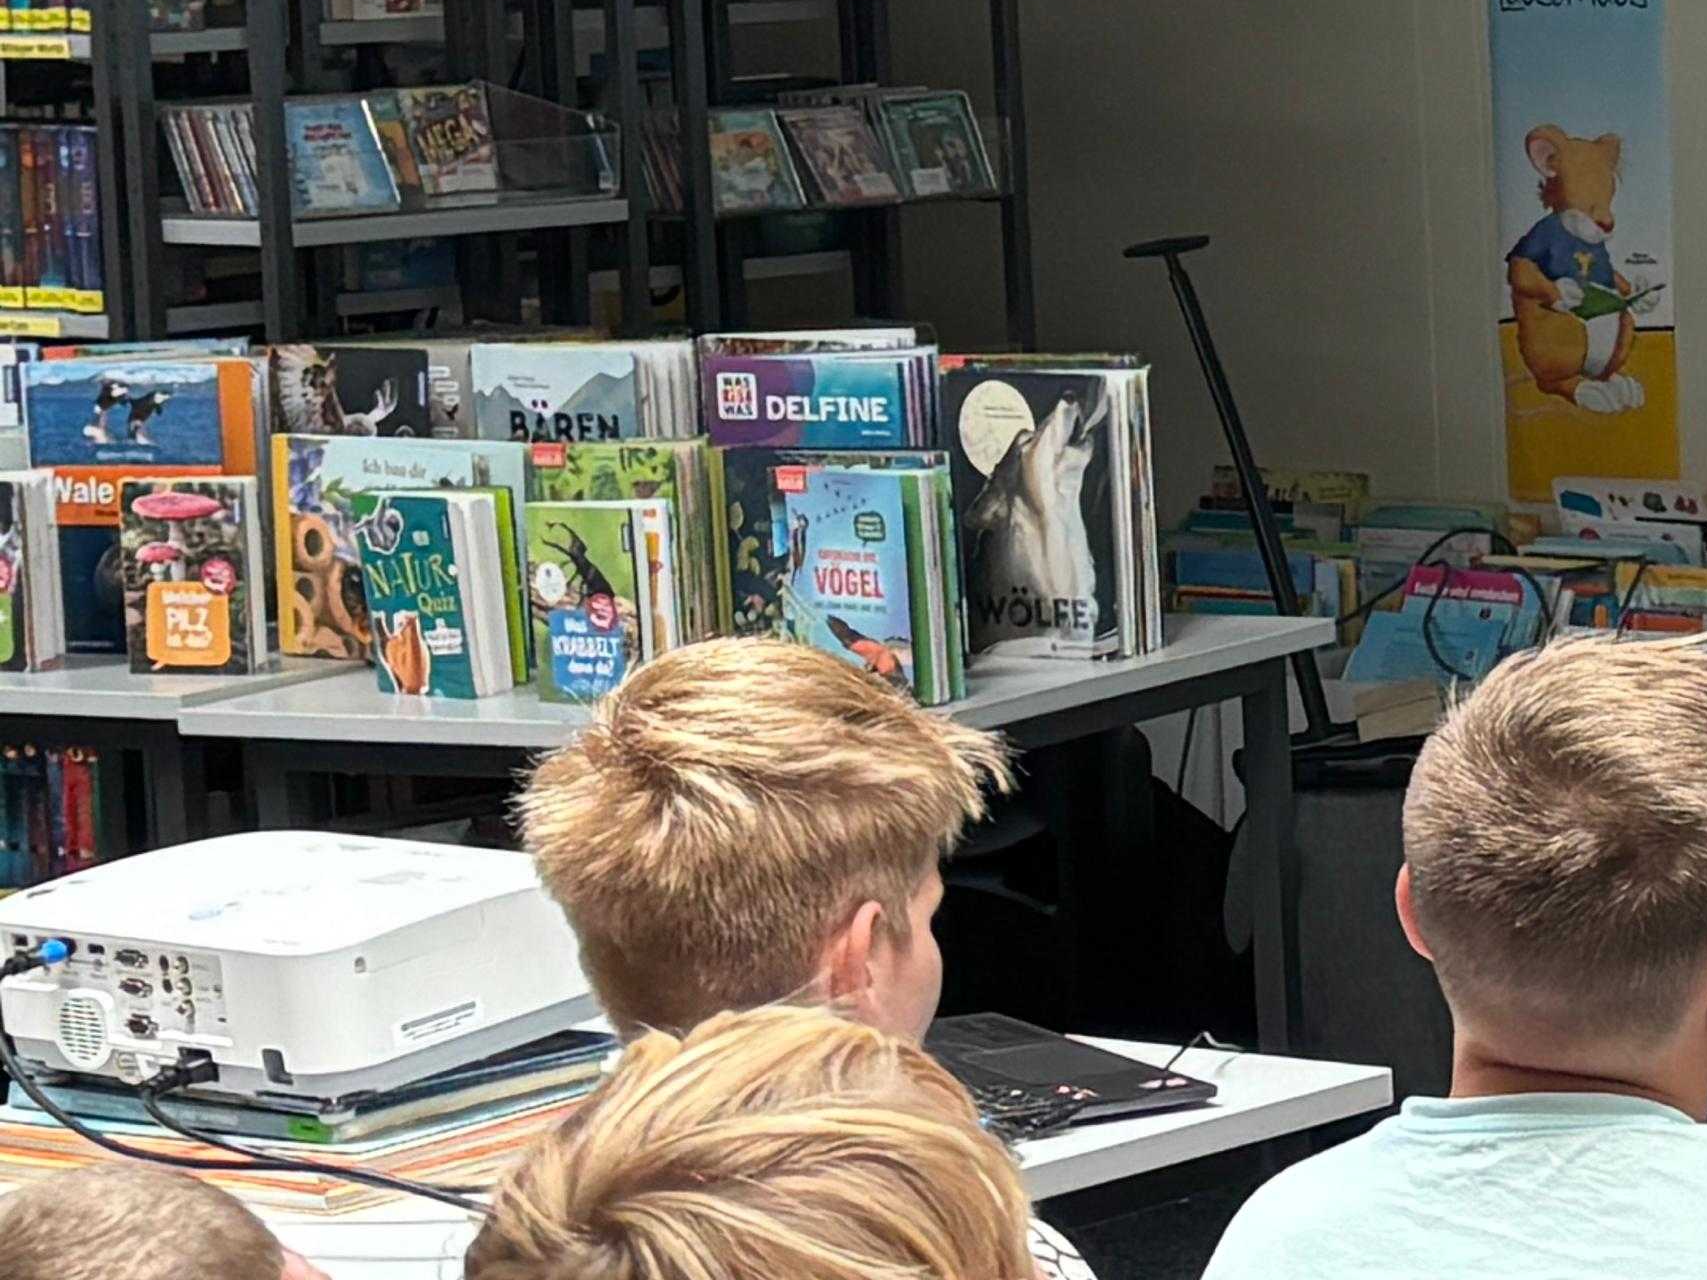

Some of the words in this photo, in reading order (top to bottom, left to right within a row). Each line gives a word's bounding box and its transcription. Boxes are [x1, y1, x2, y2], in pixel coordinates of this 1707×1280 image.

[509, 398, 620, 443] BÄREN
[766, 395, 889, 422] DELFINE
[53, 476, 114, 505] Wale
[366, 552, 455, 598] NATUR
[814, 562, 884, 599] VÖGEL
[979, 586, 1090, 629] WÖLFE
